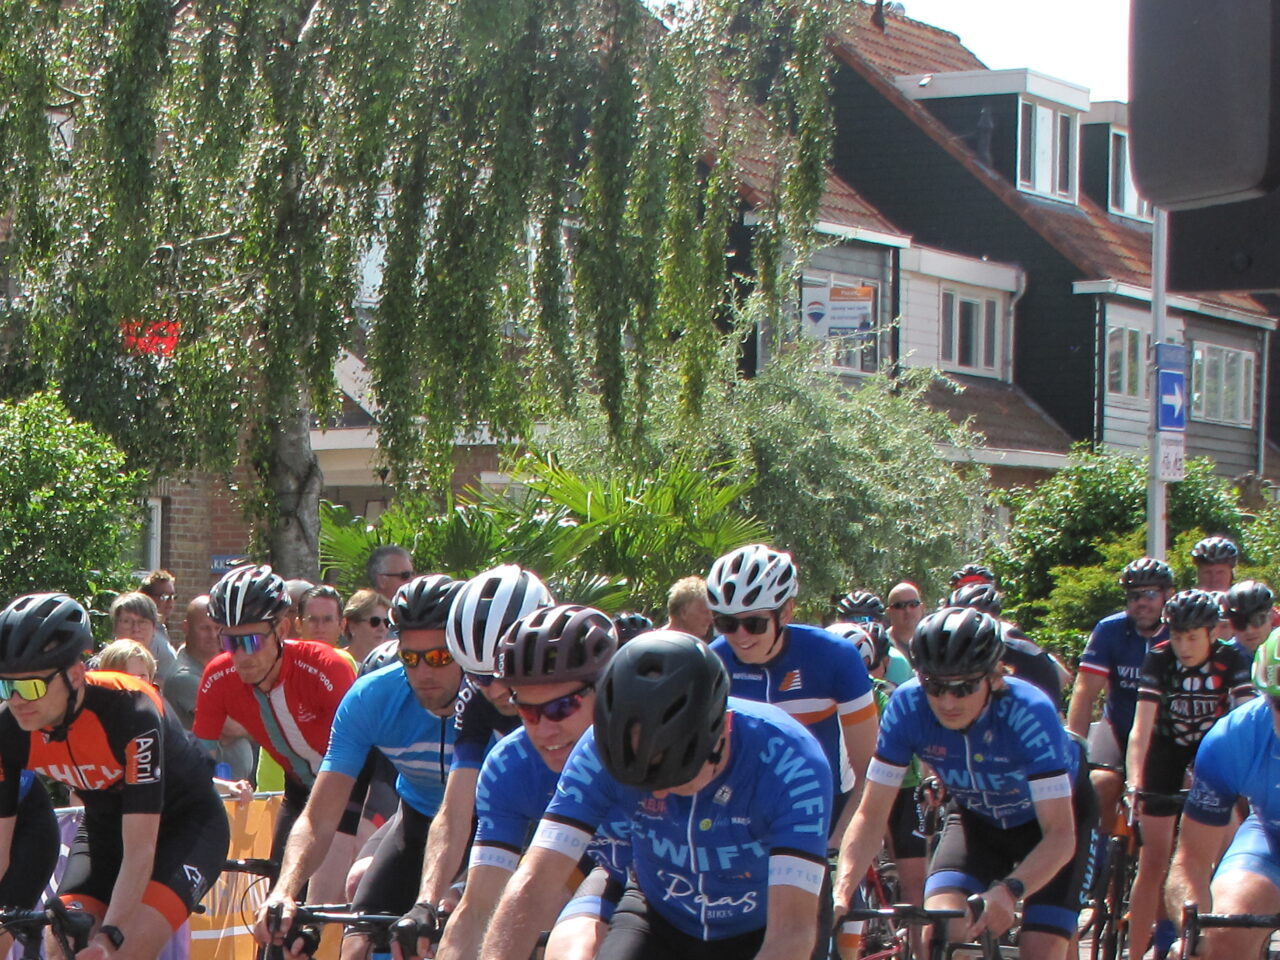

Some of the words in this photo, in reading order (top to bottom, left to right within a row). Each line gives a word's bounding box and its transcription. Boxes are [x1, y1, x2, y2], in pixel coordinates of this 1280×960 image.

[133, 738, 154, 782] April
[998, 696, 1057, 763] SWIFT
[476, 735, 528, 830] SWIFT
[759, 736, 824, 838] SWIFT
[937, 768, 1024, 791] WIFT
